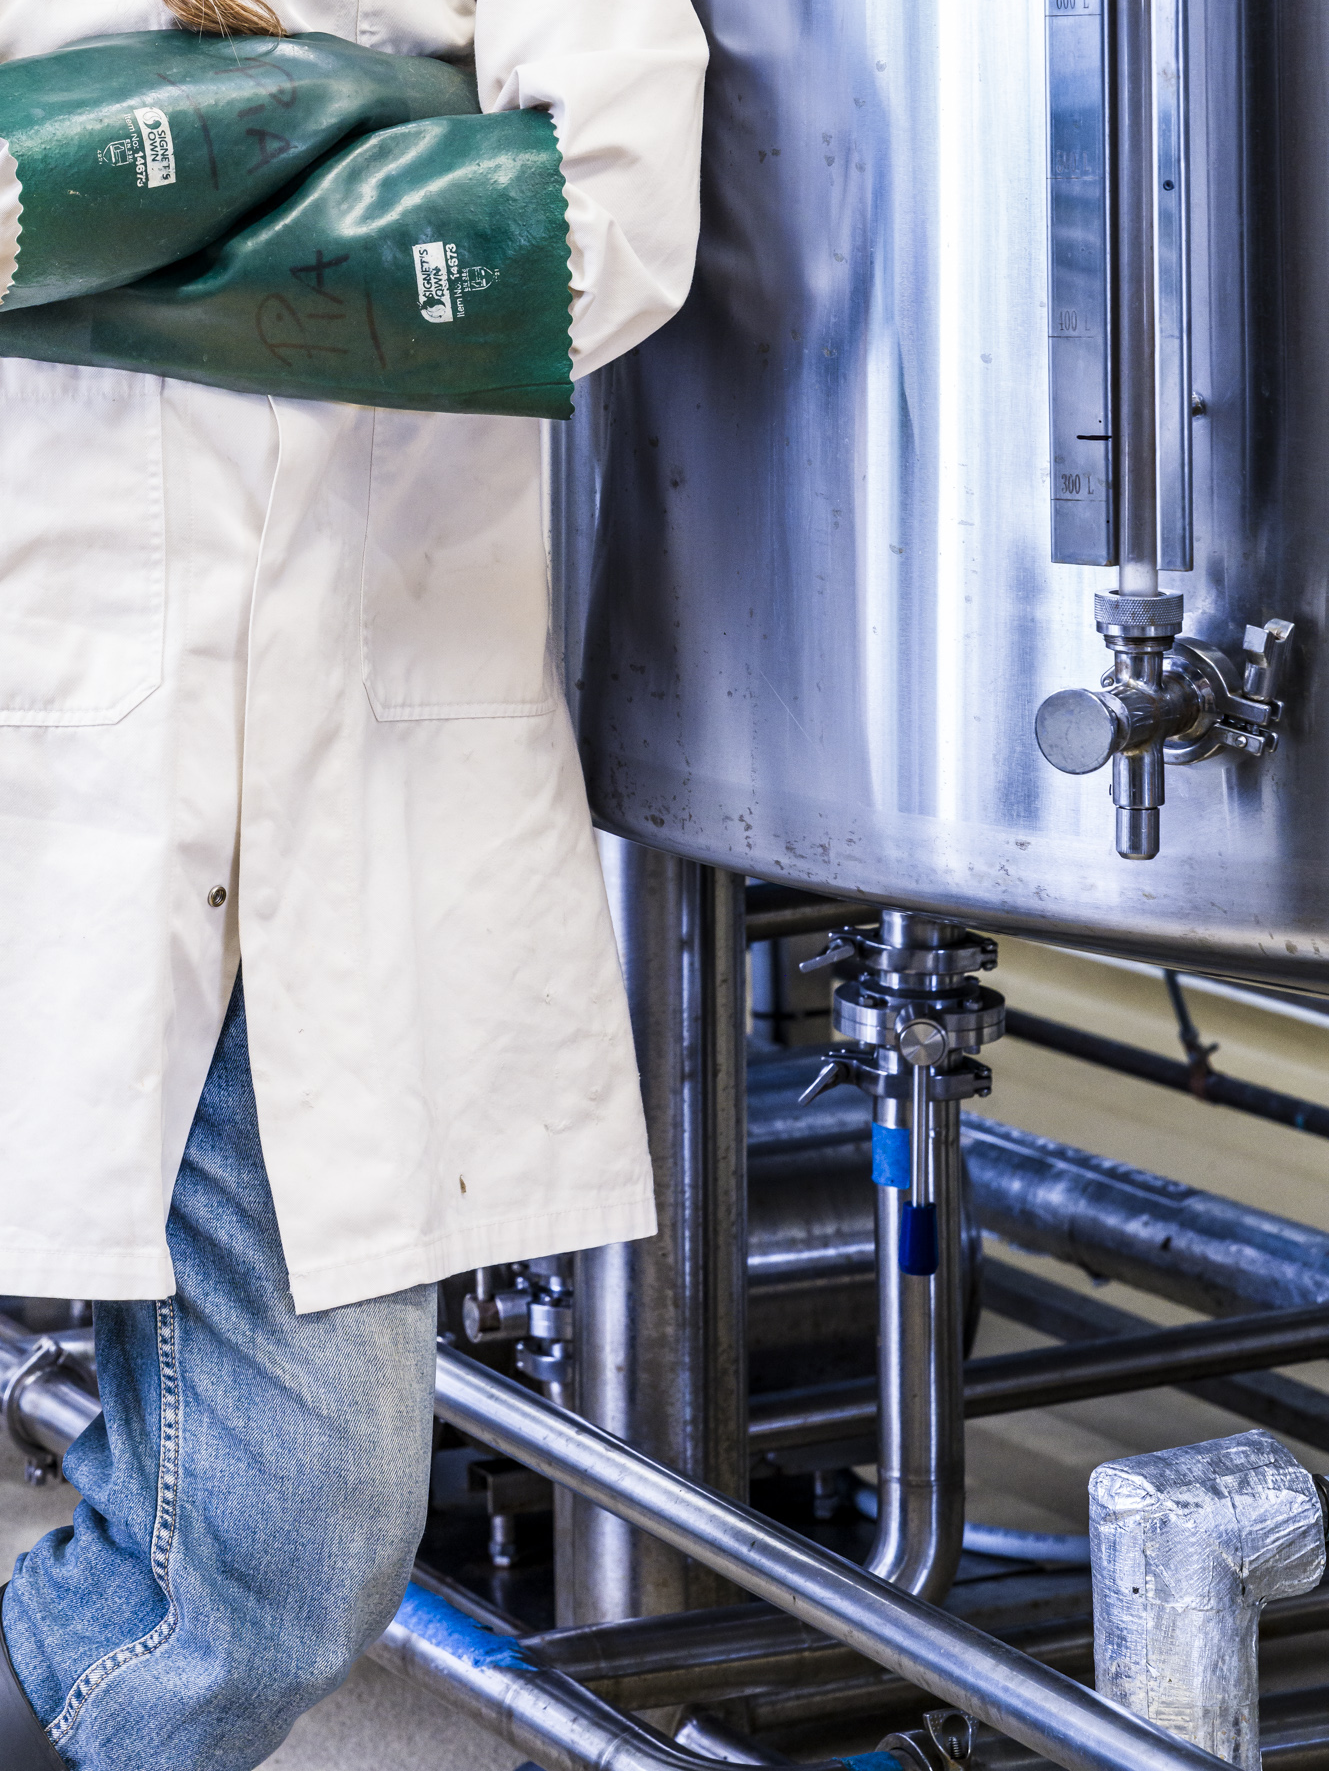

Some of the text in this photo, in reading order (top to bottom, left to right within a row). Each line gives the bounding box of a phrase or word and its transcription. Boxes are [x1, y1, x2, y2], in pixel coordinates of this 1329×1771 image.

[124, 113, 135, 132] Item
[134, 151, 146, 187] 14673
[147, 132, 159, 162] OWN
[157, 130, 171, 181] SIGNET'S
[418, 248, 433, 298] SIGNET'S
[446, 243, 459, 280] 14673
[432, 266, 445, 298] OWN
[456, 298, 465, 318] Item
[1058, 310, 1078, 331] 400
[1061, 473, 1094, 495] 300 L
